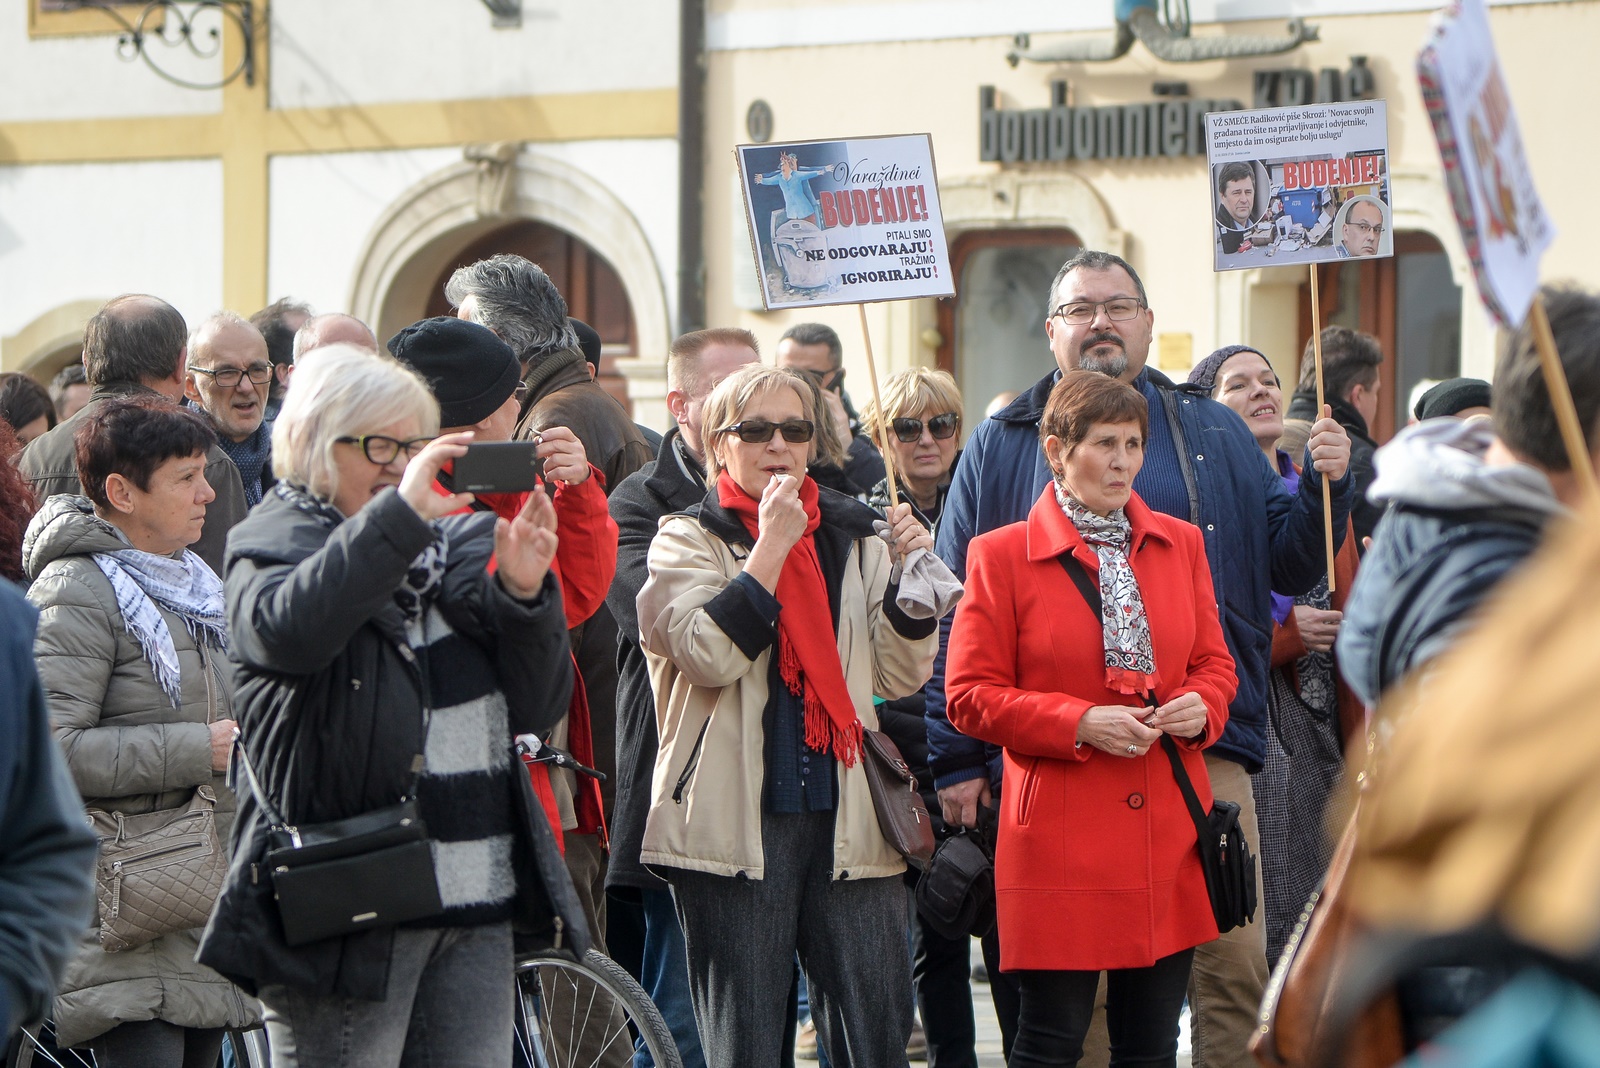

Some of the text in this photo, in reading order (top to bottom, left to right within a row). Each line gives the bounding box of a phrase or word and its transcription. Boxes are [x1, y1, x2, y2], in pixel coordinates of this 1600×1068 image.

[1213, 116, 1223, 127] VŽ
[1250, 112, 1286, 124] Radiković
[1286, 112, 1301, 122] piše
[1302, 110, 1326, 120] Skrozi:
[1354, 106, 1374, 116] svojih
[1244, 126, 1267, 136] trošite
[1278, 122, 1324, 134] prijavljivanje
[1328, 118, 1368, 128] odvjetnike,
[1214, 138, 1243, 149] umjesto
[1244, 136, 1253, 146] da
[1254, 136, 1264, 145] im
[1265, 134, 1299, 146] osigurate
[1300, 131, 1318, 142] bolju
[832, 157, 922, 193] Varaždinci
[886, 228, 932, 240] PITALI SMO
[804, 250, 826, 262] NE
[899, 254, 936, 266] TRAŽIMO
